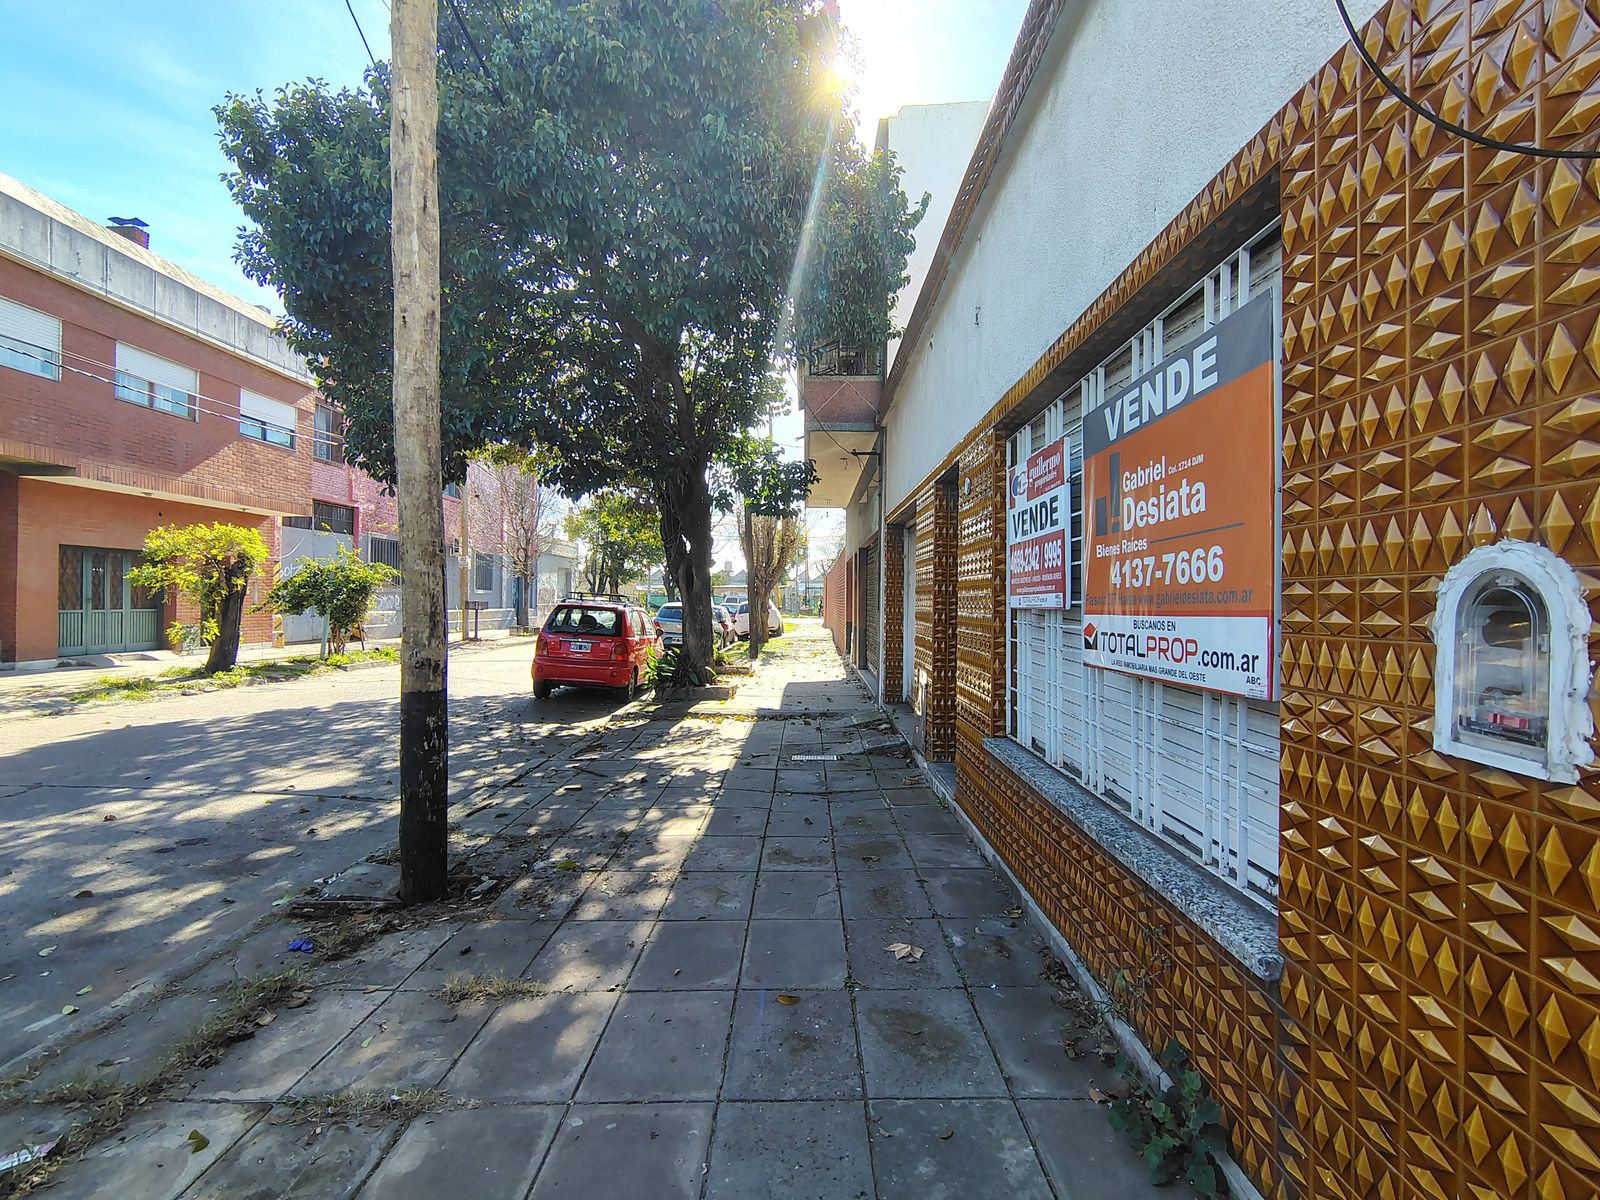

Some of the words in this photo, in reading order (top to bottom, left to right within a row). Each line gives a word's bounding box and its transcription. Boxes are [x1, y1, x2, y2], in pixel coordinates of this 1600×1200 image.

[1104, 335, 1218, 442] VENDE
[1122, 456, 1165, 492] Gabriel
[1012, 494, 1059, 539] VENDE
[1123, 478, 1206, 531] Desiata
[1044, 539, 1062, 569] 9995
[1096, 542, 1120, 558] Bienes
[1112, 545, 1224, 588] 4137-7666
[1133, 619, 1165, 631] BUSCANOS
[1167, 621, 1176, 632] EN
[1149, 665, 1158, 674] MAS
[1159, 667, 1178, 677] GRANDE
[1178, 670, 1188, 679] DEL
[1189, 672, 1206, 682] OESTE
[1246, 676, 1261, 685] ABC
